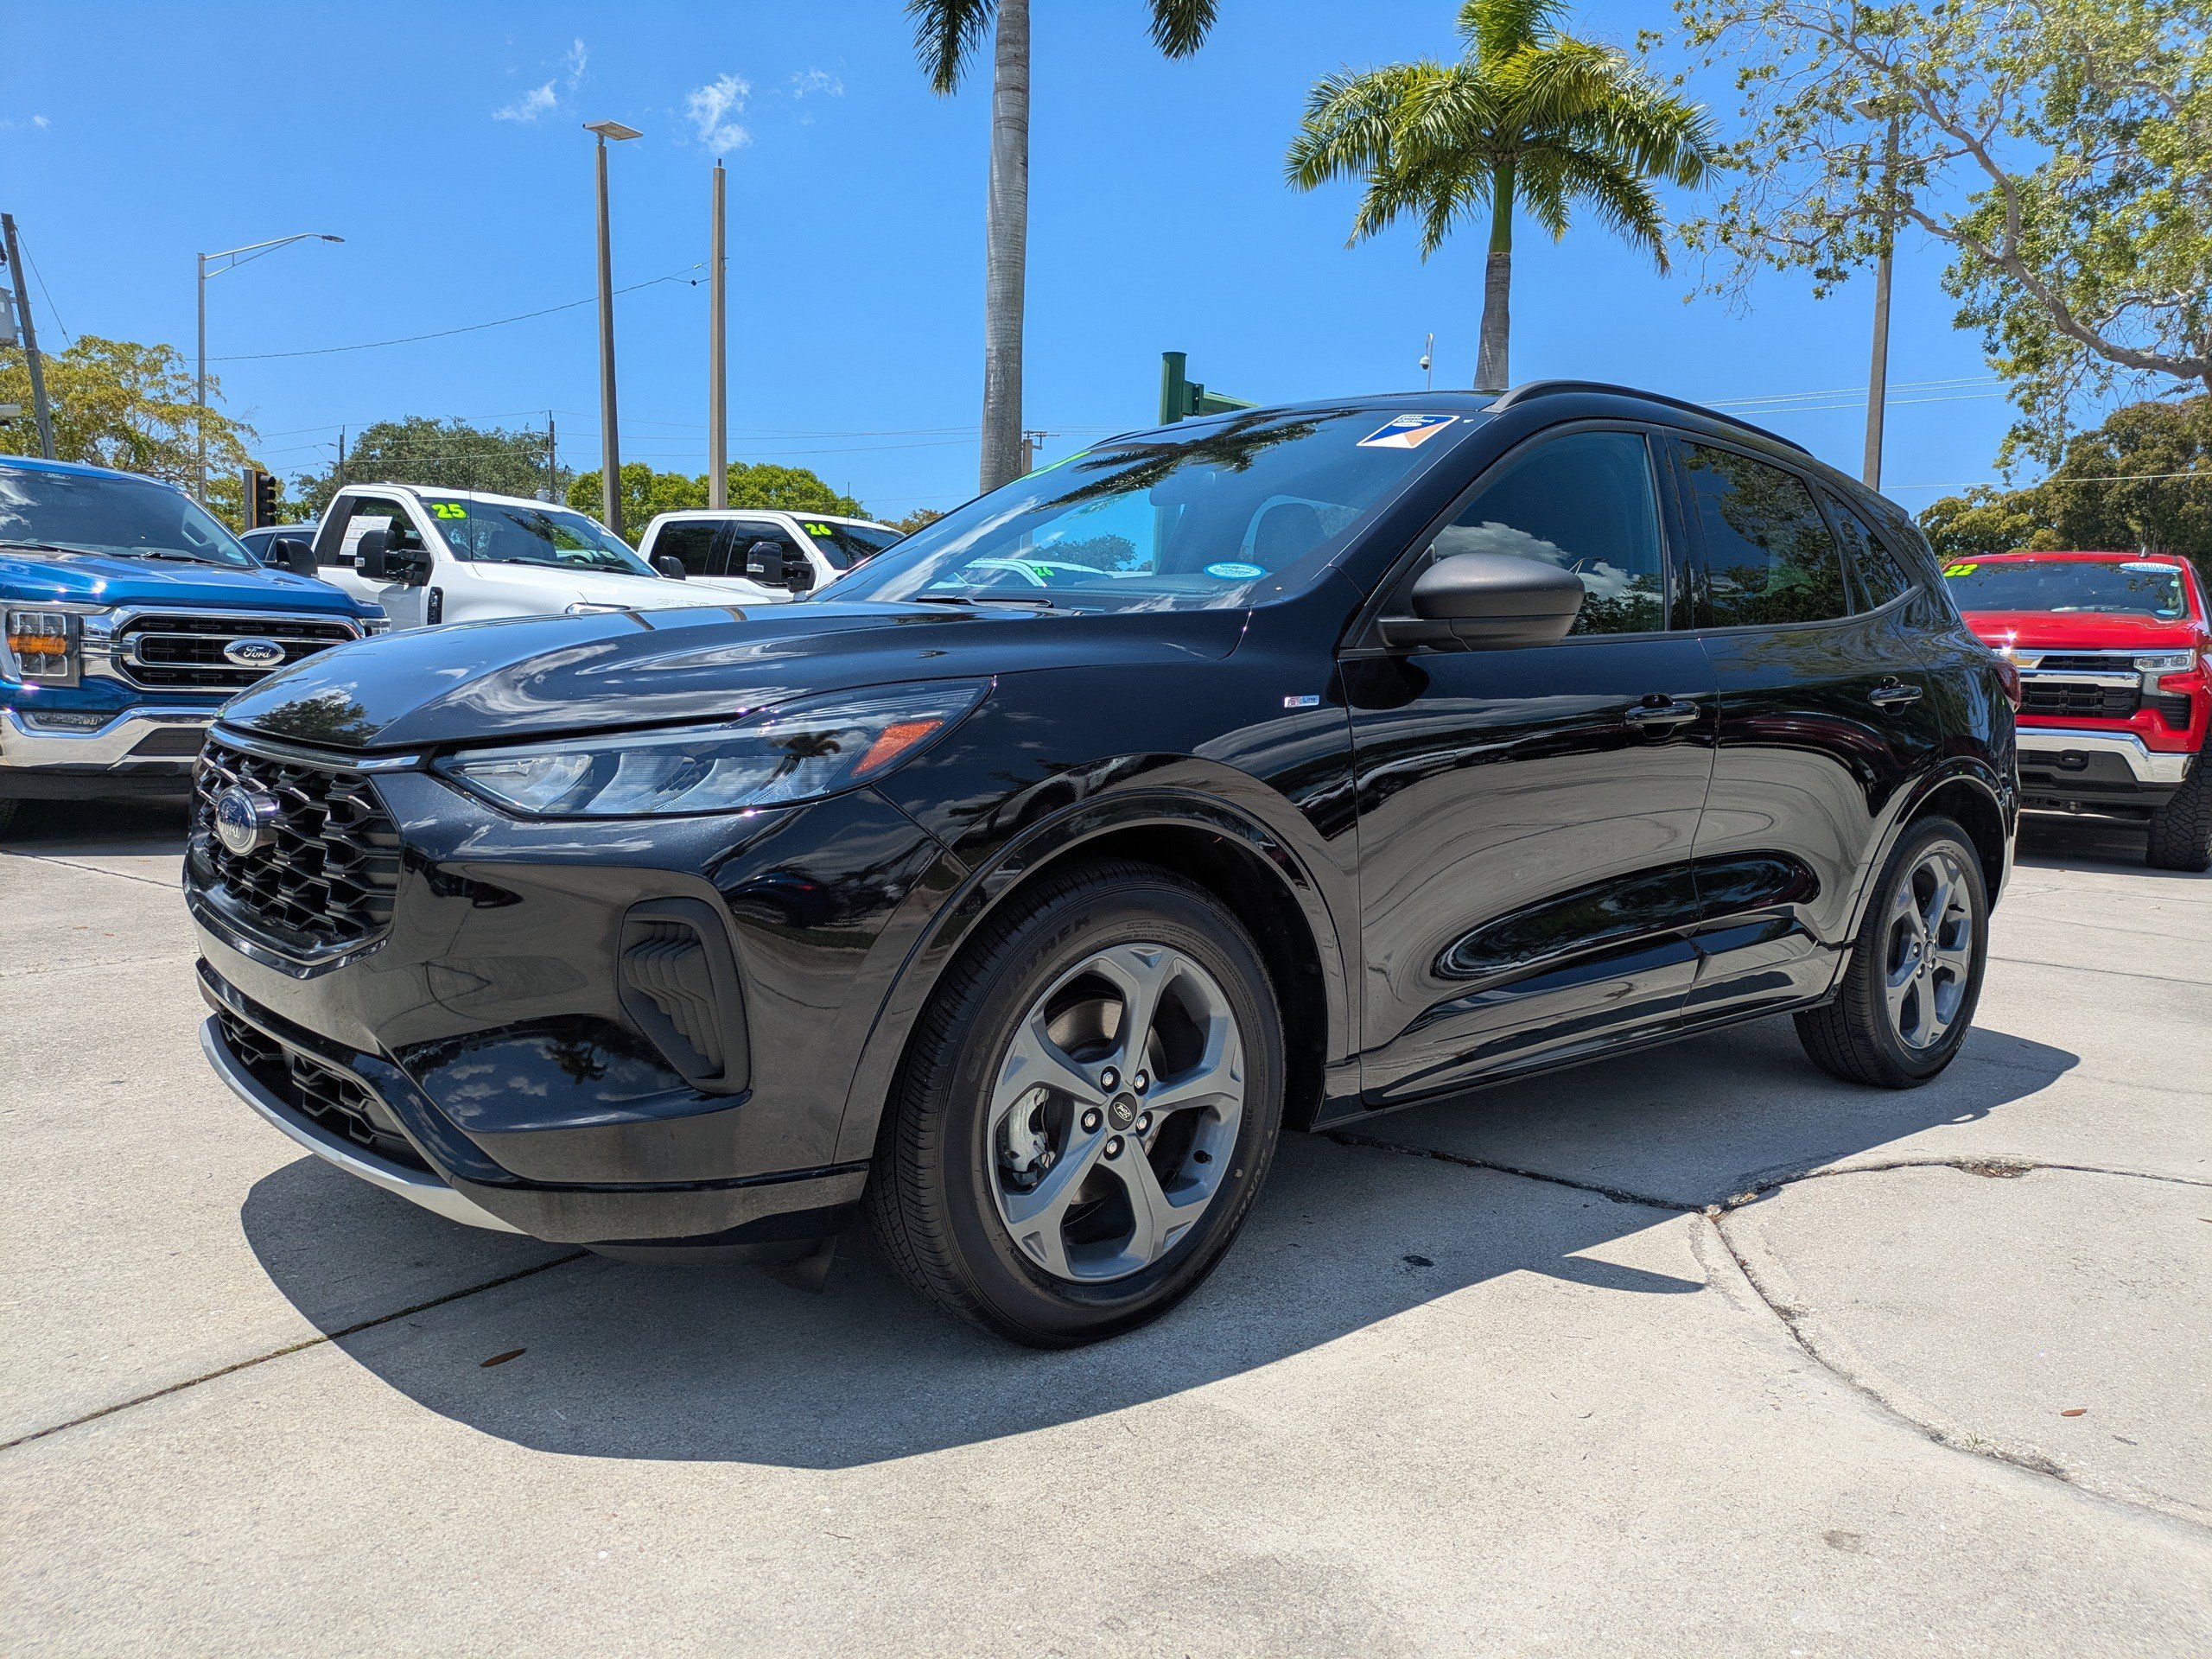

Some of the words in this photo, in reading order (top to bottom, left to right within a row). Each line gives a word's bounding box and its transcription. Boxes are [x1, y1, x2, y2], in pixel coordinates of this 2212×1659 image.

[431, 503, 467, 519] 25
[804, 522, 832, 536] 26
[1032, 566, 1055, 577] 26
[1943, 563, 1979, 577] 22
[243, 645, 272, 658] Ford
[1116, 1104, 1132, 1120] Ford
